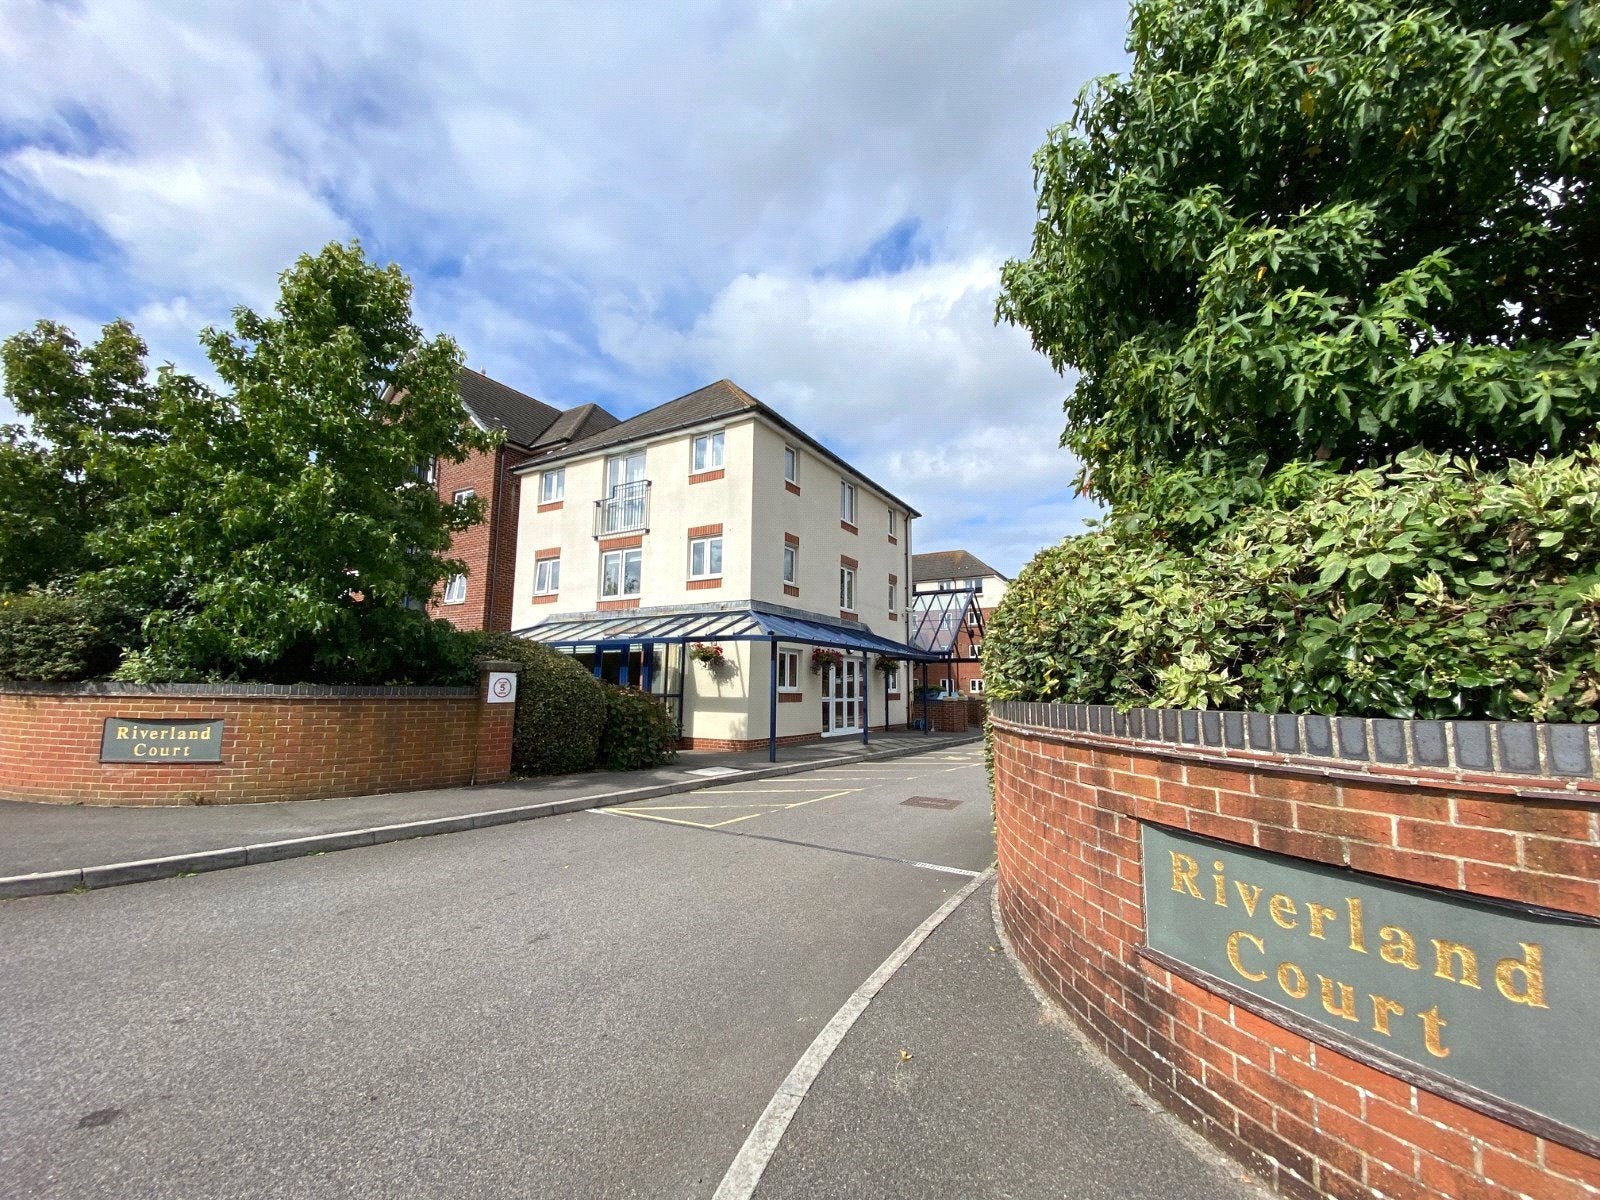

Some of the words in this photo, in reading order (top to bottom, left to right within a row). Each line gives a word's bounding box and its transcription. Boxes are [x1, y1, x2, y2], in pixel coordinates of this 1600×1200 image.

[499, 683, 506, 691] 5
[115, 725, 212, 740] Riverland
[133, 743, 190, 757] Court
[1168, 850, 1549, 1009] Riverland
[1225, 930, 1451, 1059] Court
